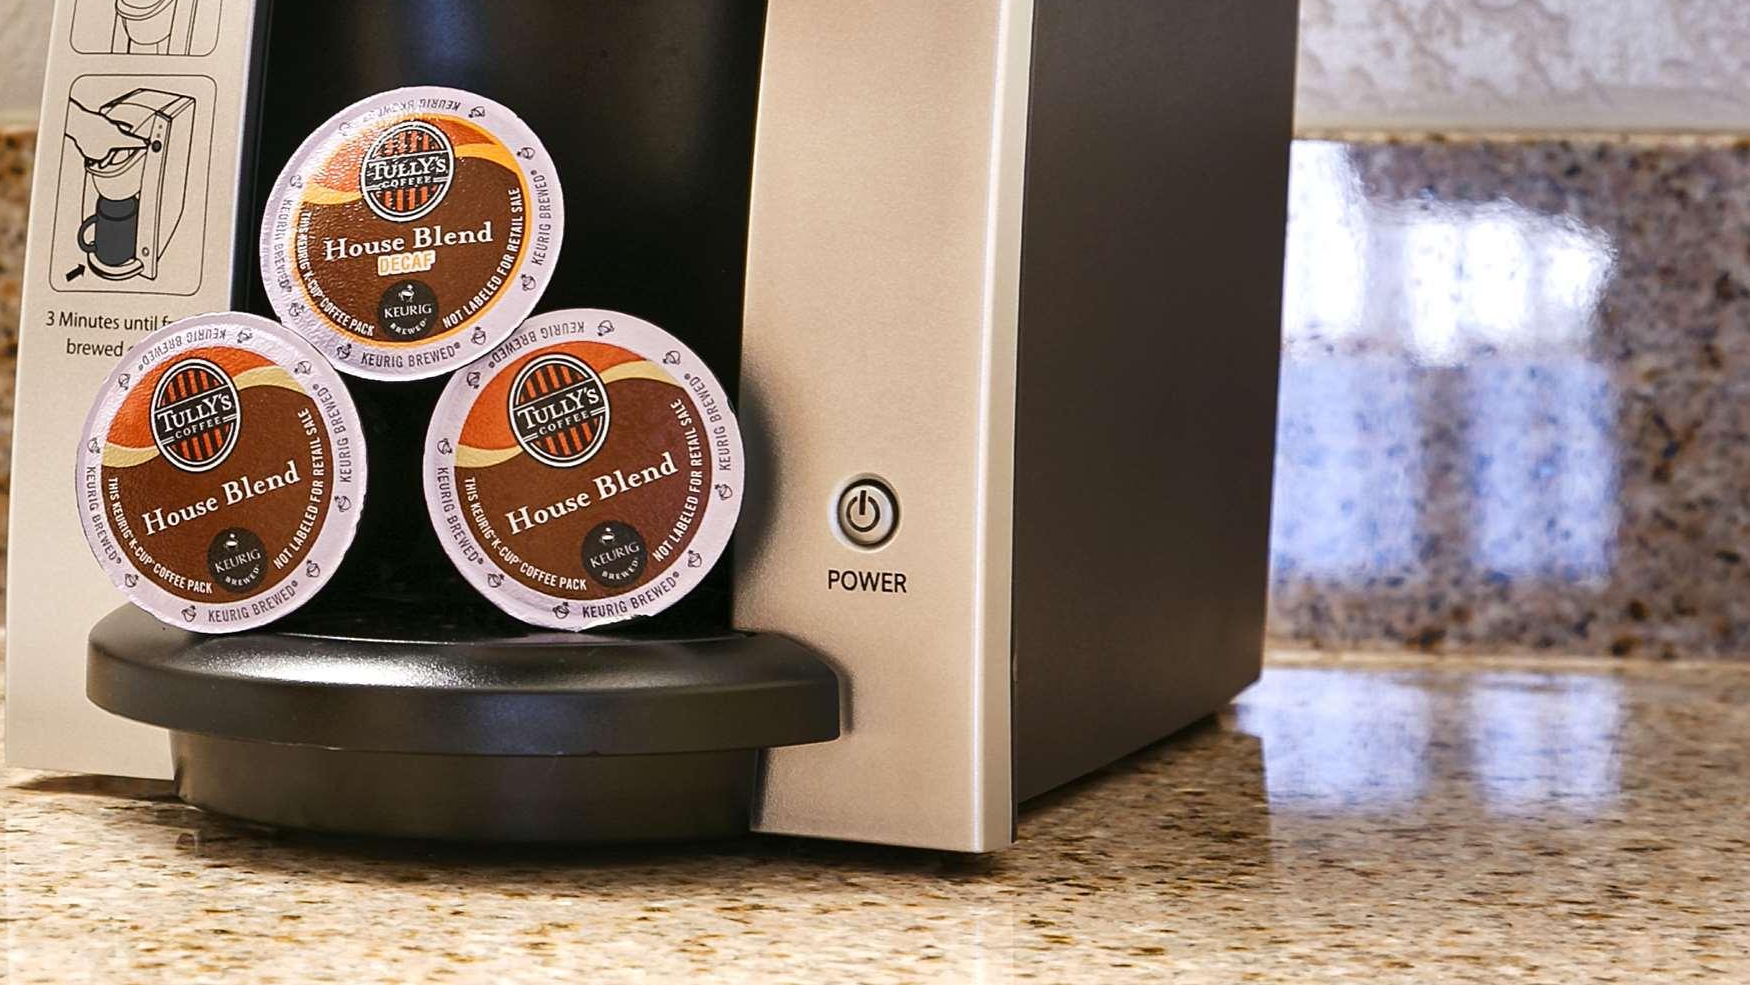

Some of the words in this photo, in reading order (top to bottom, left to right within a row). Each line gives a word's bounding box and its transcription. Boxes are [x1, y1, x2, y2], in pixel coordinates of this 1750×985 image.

[369, 156, 447, 181] TULLY'S
[381, 176, 431, 188] COFFEE
[508, 187, 523, 213] SALE
[323, 237, 405, 261] House
[413, 221, 493, 249] Blend
[508, 216, 523, 253] RETAIL
[531, 223, 551, 266] KEURIG
[379, 252, 435, 275] DECAF
[497, 254, 515, 276] FOR
[462, 276, 502, 316] LABELED
[46, 310, 55, 327] 3
[59, 311, 120, 330] Minutes
[124, 315, 158, 332] until
[320, 297, 351, 326] COFFEE
[349, 319, 375, 336] PACK
[384, 303, 432, 319] KEURIG
[442, 310, 463, 329] NOT
[187, 328, 227, 344] KEURIG
[540, 321, 585, 339] KEURIG
[66, 337, 124, 357] brewed
[361, 351, 403, 367] KEURIG
[157, 393, 232, 433] TULLY'S
[517, 387, 600, 429] TULLY'S
[670, 398, 692, 427] SALE
[175, 416, 222, 439] COFFEE
[297, 407, 318, 436] SALE
[539, 411, 589, 435] COFFEE
[310, 436, 324, 476] RETAIL
[337, 437, 351, 483] KEURIG
[685, 429, 702, 466] RETAIL
[714, 426, 731, 471] KEURIG
[85, 466, 100, 511] KEURIG
[313, 481, 324, 503] FOR
[437, 467, 455, 513] KEURIG
[505, 492, 591, 535] House
[592, 451, 679, 501] Blend
[689, 471, 702, 493] FOR
[142, 497, 219, 536] House
[221, 459, 301, 505] Blend
[290, 505, 319, 551] LABELED
[669, 495, 699, 543] LABELED
[108, 477, 120, 502] THIS
[153, 563, 186, 591] COFFEE
[187, 580, 213, 594] PACK
[464, 477, 479, 501] THIS
[520, 562, 556, 587] COFFEE
[559, 577, 587, 591] PACK
[214, 548, 261, 573] KEURIG
[273, 549, 293, 570] NOT
[590, 541, 640, 568] KEURIG
[652, 540, 674, 562] NOT
[828, 569, 907, 594] POWER
[208, 607, 249, 623] KEURIG
[582, 600, 628, 618] KEURIG
